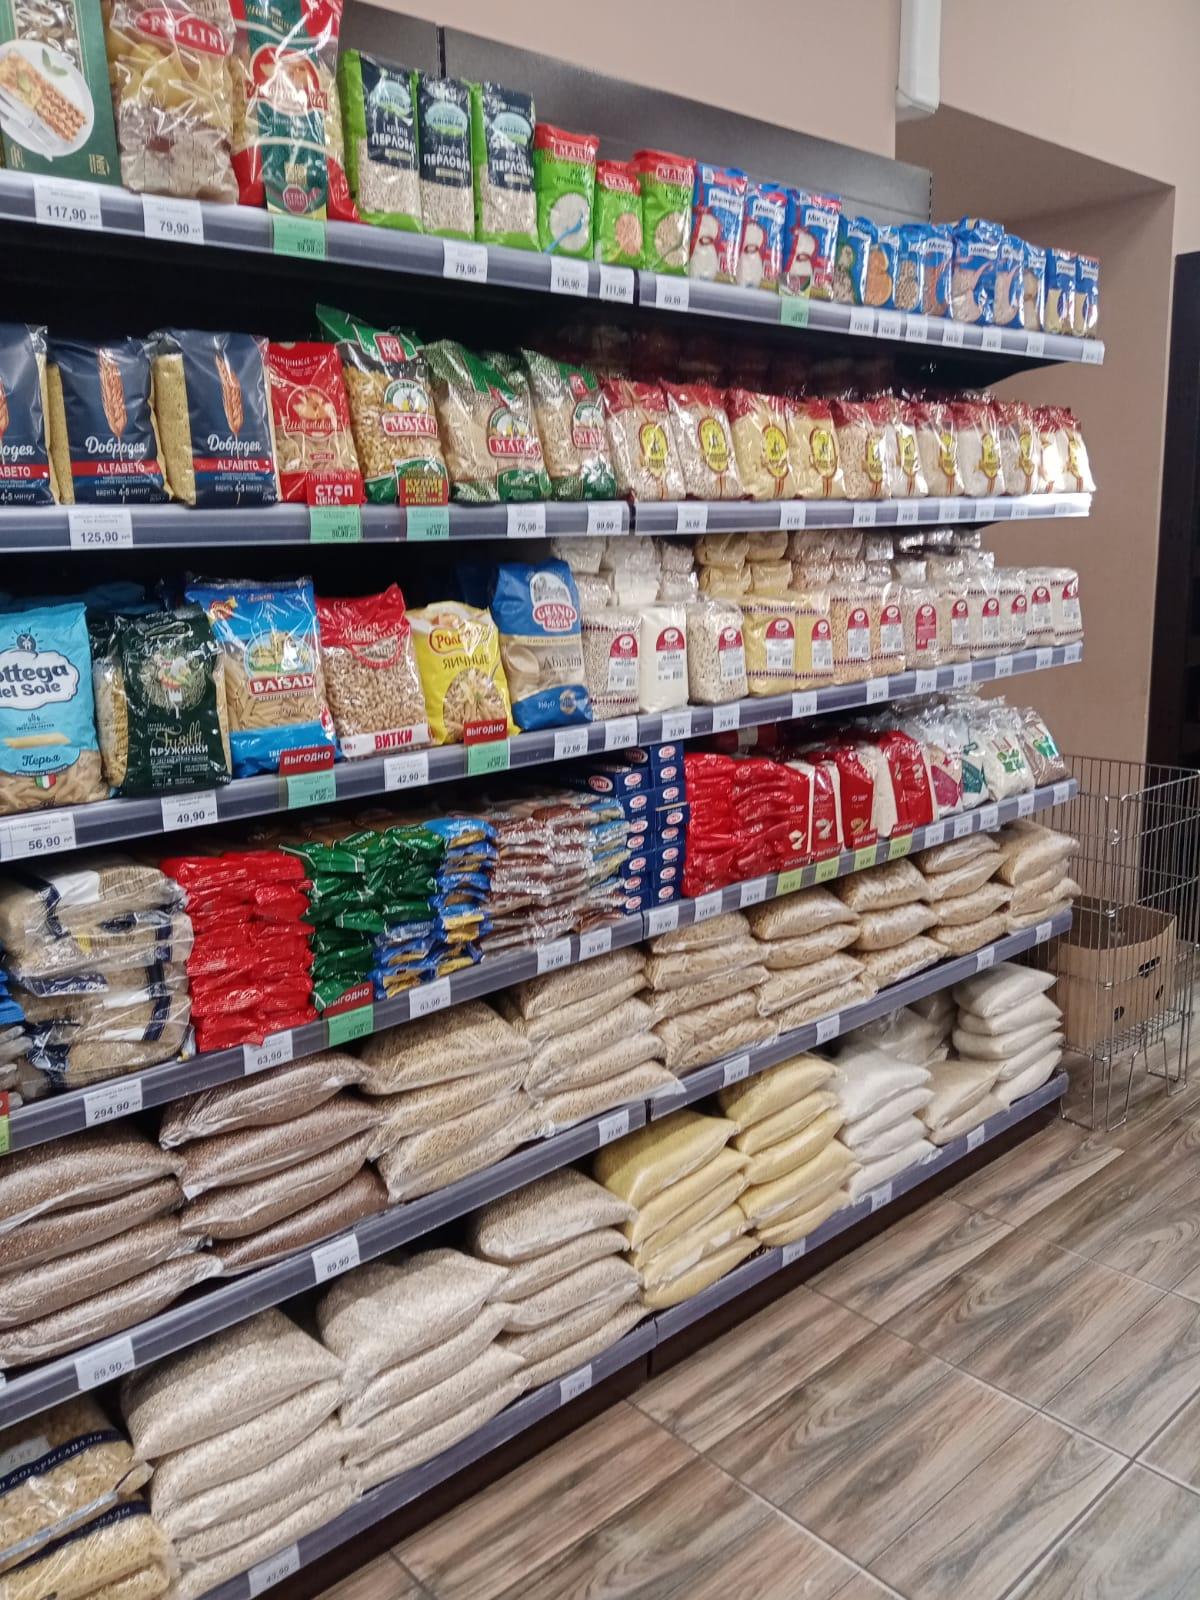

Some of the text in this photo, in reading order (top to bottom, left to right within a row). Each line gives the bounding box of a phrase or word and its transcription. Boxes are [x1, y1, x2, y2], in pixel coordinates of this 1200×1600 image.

[47, 204, 87, 222] 117,90
[159, 219, 190, 235] 79,90
[85, 435, 148, 461] Добродея
[207, 433, 262, 457] Добродея
[96, 461, 145, 474] ALFABETO
[217, 459, 260, 471] ALFABETO
[315, 484, 354, 497] СТОП
[315, 497, 340, 505] ЦЕНА
[80, 531, 119, 543] 125,90
[535, 604, 573, 621] GRAND
[442, 655, 490, 670] ЯИЧНЫЕ
[21, 681, 61, 696] Sole
[466, 723, 505, 737] ВЫГОДНО
[374, 729, 414, 750] ВИТКИ
[149, 743, 209, 757] ПРУЖИНКИ
[22, 753, 61, 768] Перья
[283, 751, 331, 766] ВЫГОДНО
[176, 810, 206, 824] 49,90
[28, 835, 61, 850] 56,90
[94, 1101, 130, 1120] 294,90
